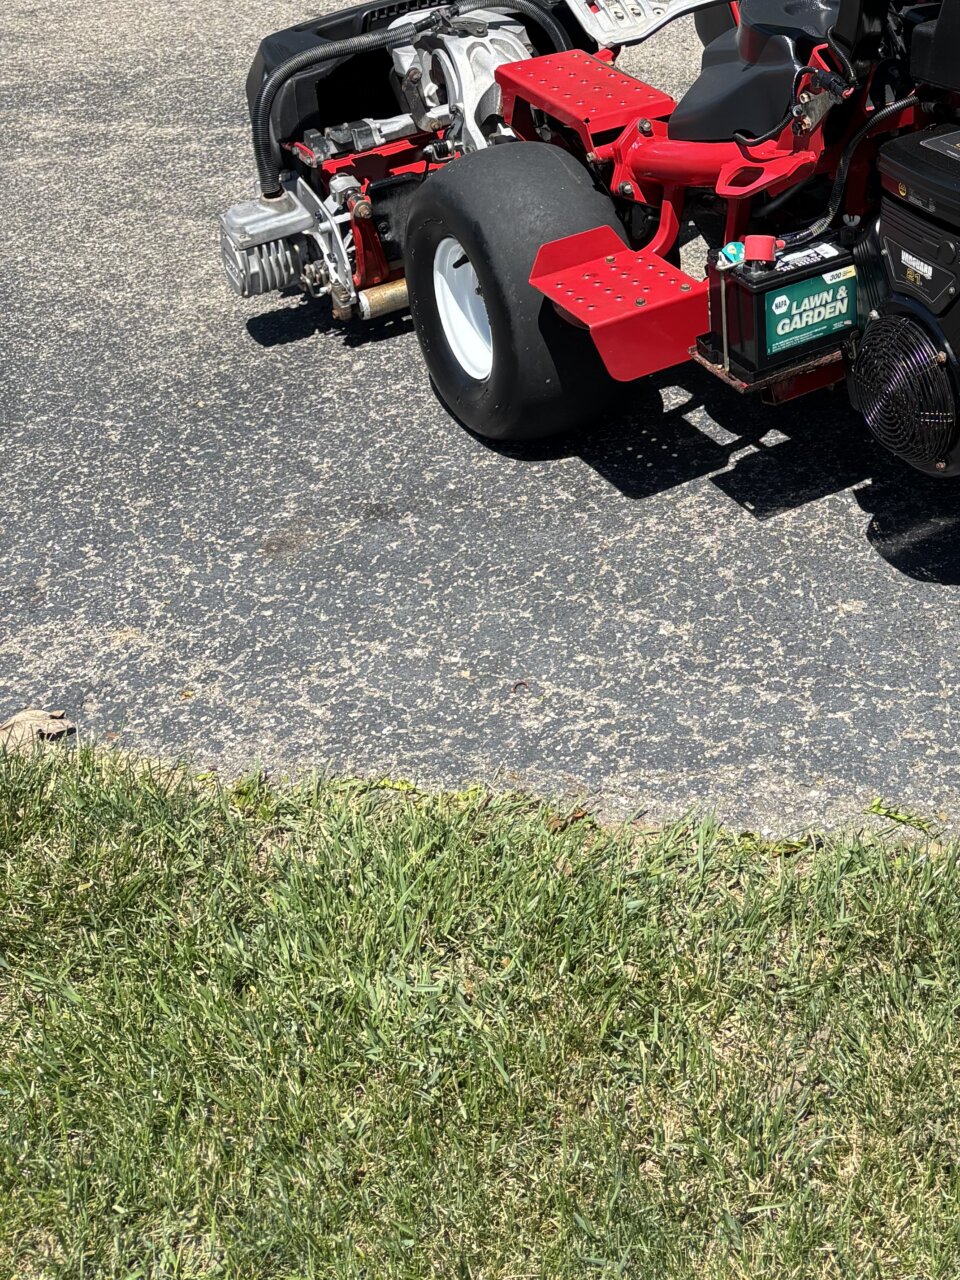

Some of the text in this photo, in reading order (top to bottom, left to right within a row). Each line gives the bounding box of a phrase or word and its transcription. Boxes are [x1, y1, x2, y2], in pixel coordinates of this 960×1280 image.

[830, 272, 842, 282] 300
[774, 299, 787, 309] NAPA
[791, 285, 848, 316] LAWN &
[776, 297, 849, 336] GARDEN
